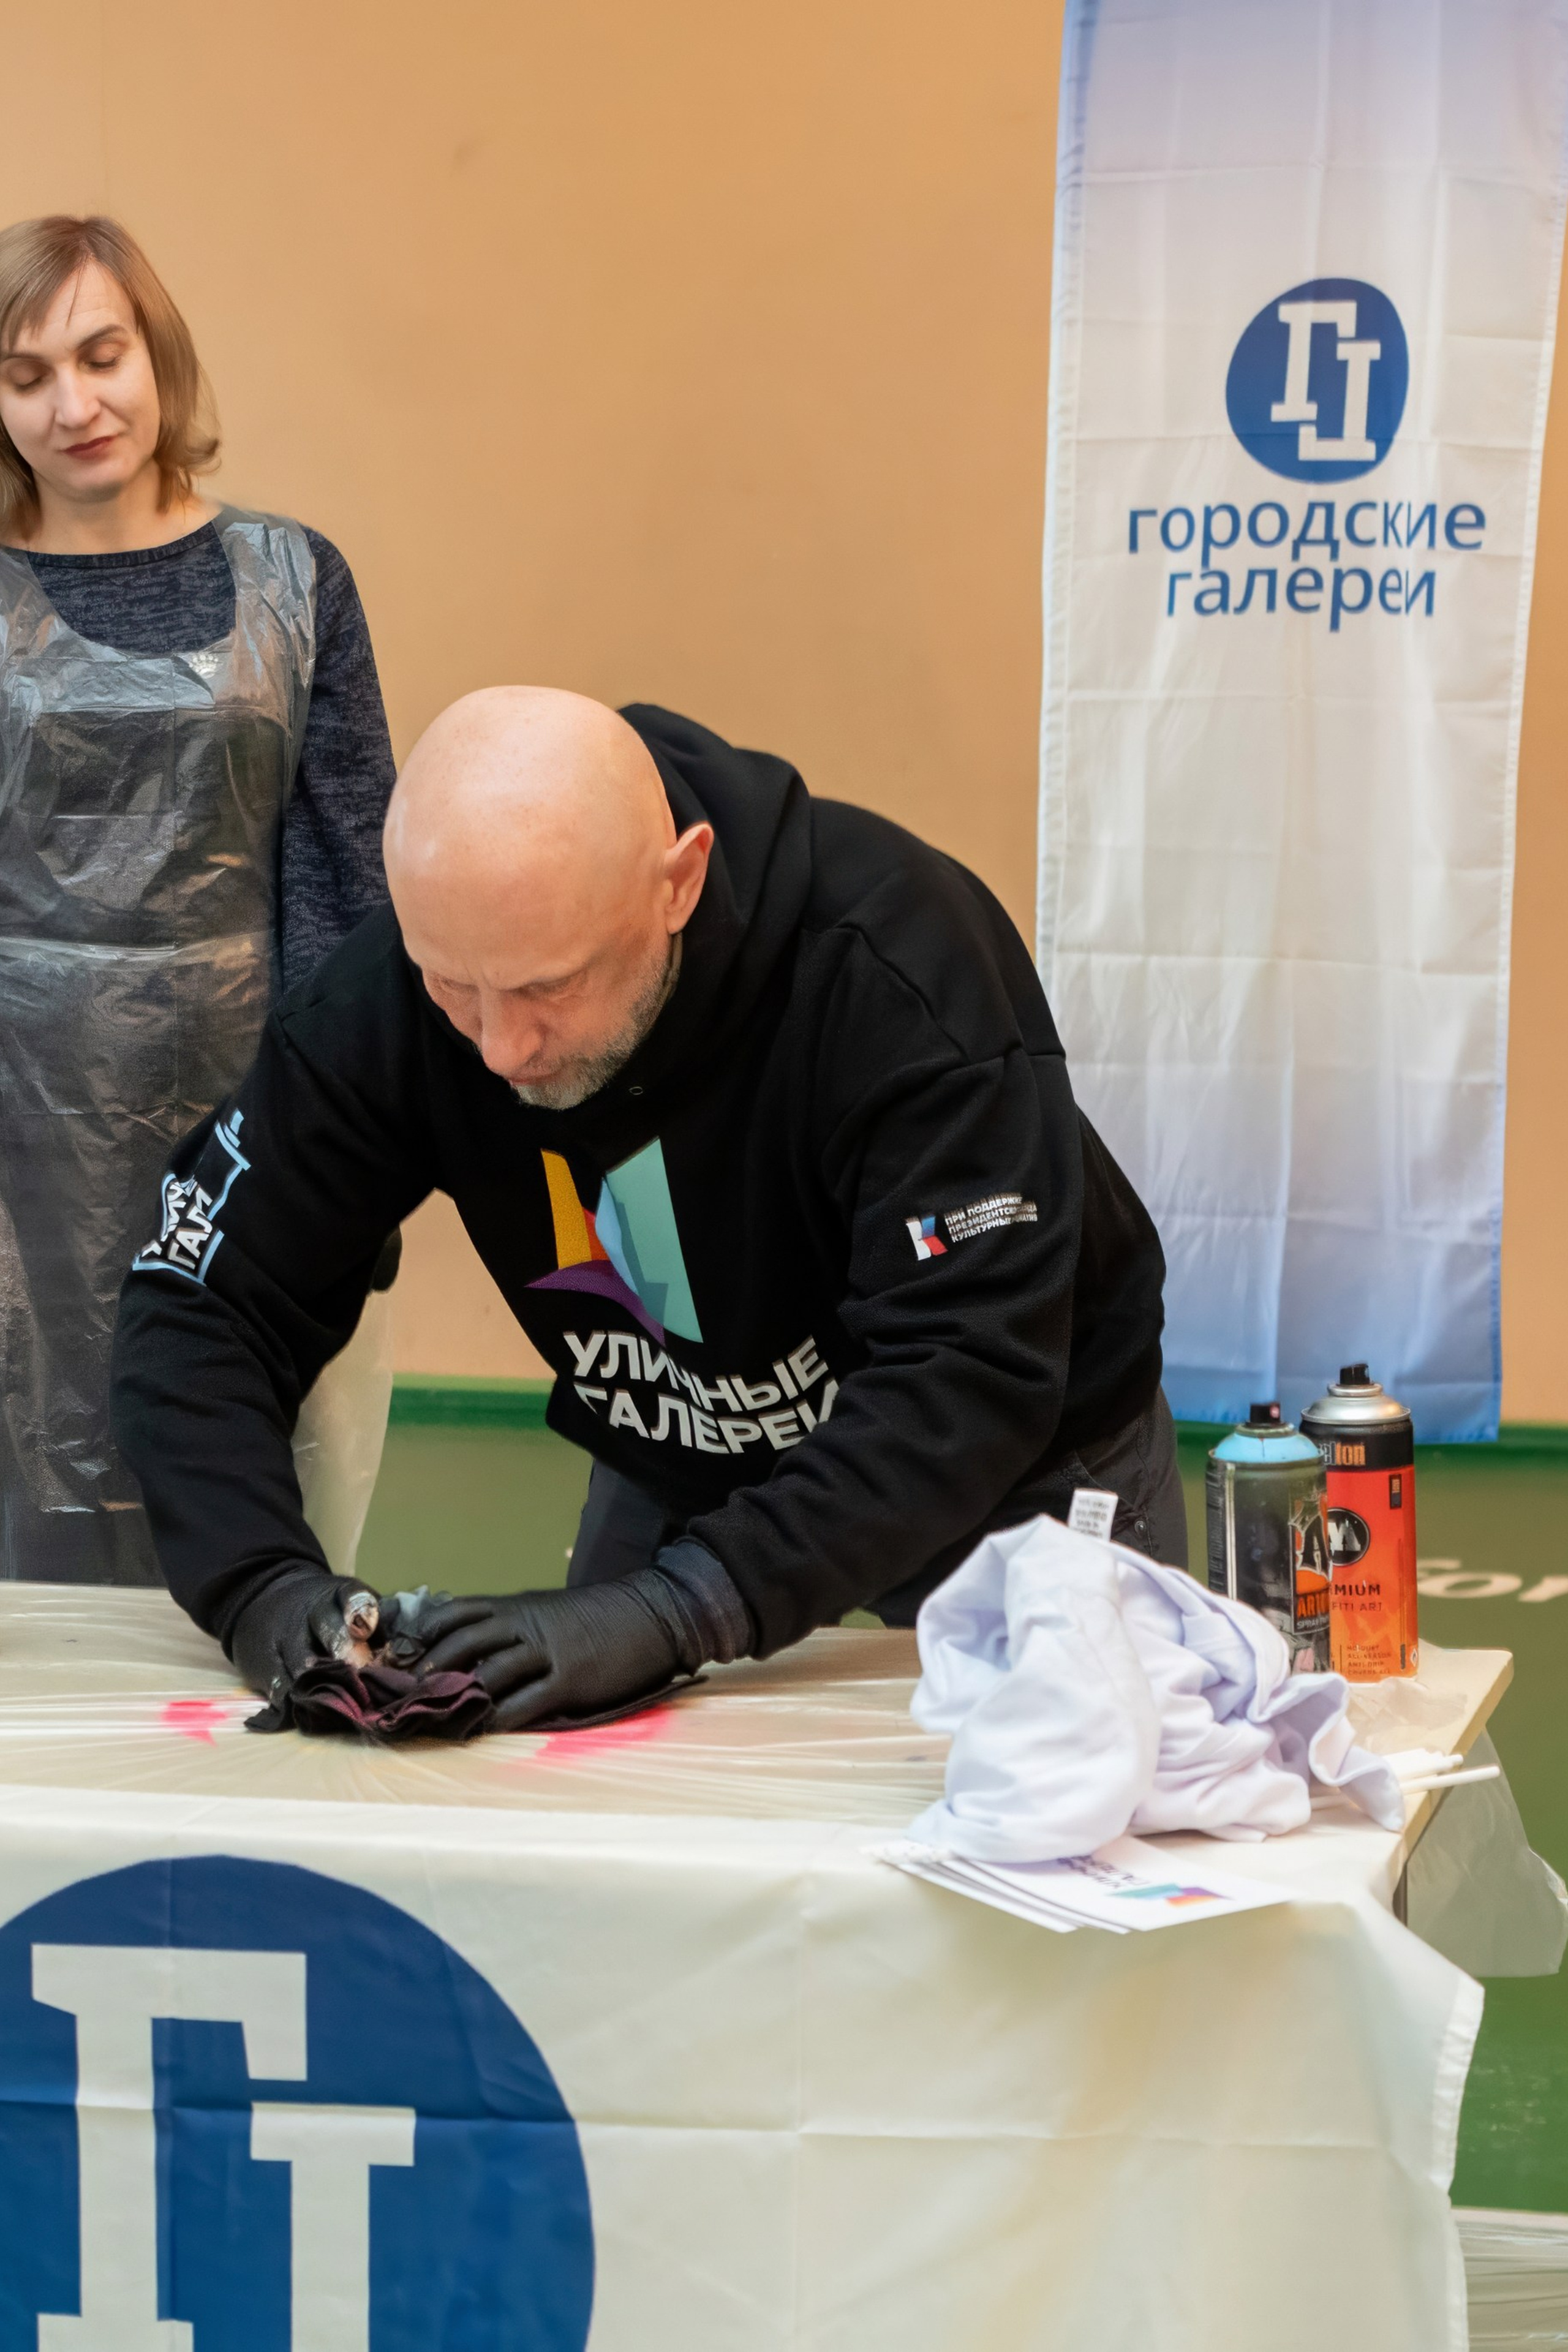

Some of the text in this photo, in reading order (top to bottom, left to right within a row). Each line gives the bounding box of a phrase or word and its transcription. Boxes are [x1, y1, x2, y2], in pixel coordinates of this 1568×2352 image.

[1129, 500, 1487, 570] городские
[1167, 565, 1437, 633] галереи
[945, 1196, 1023, 1225] ПРИ ПОДДЕРЖКЕ
[562, 1332, 829, 1412] УЛИЧНЫЕ
[1329, 1584, 1381, 1596] MIUM
